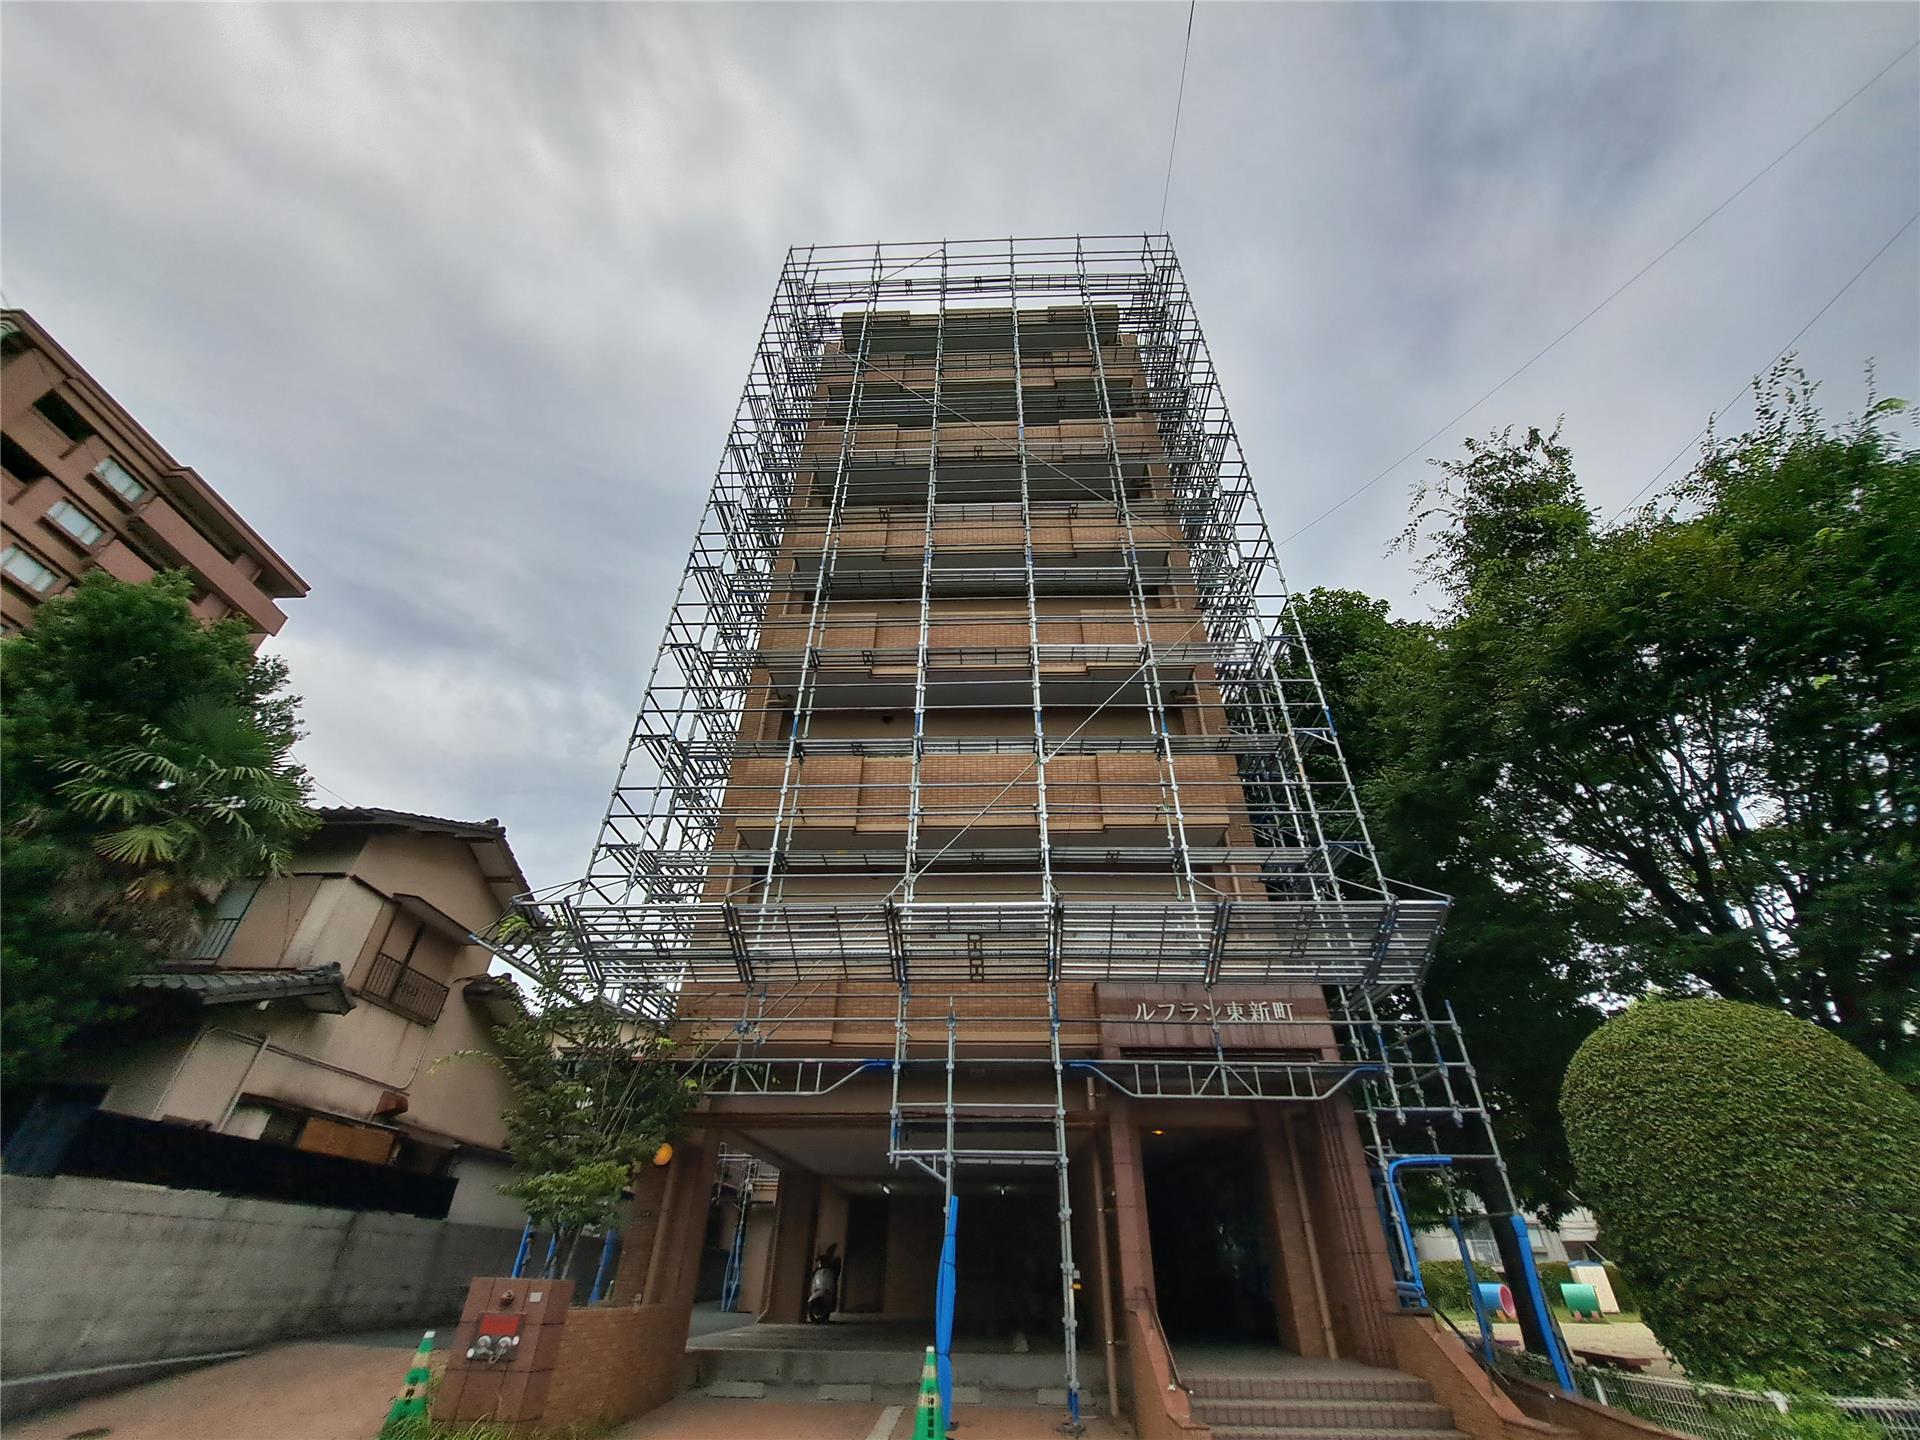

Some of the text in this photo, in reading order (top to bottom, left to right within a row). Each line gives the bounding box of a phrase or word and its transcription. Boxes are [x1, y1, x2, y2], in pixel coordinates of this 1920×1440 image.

[1135, 1001, 1294, 1022] ルフラン東新町
